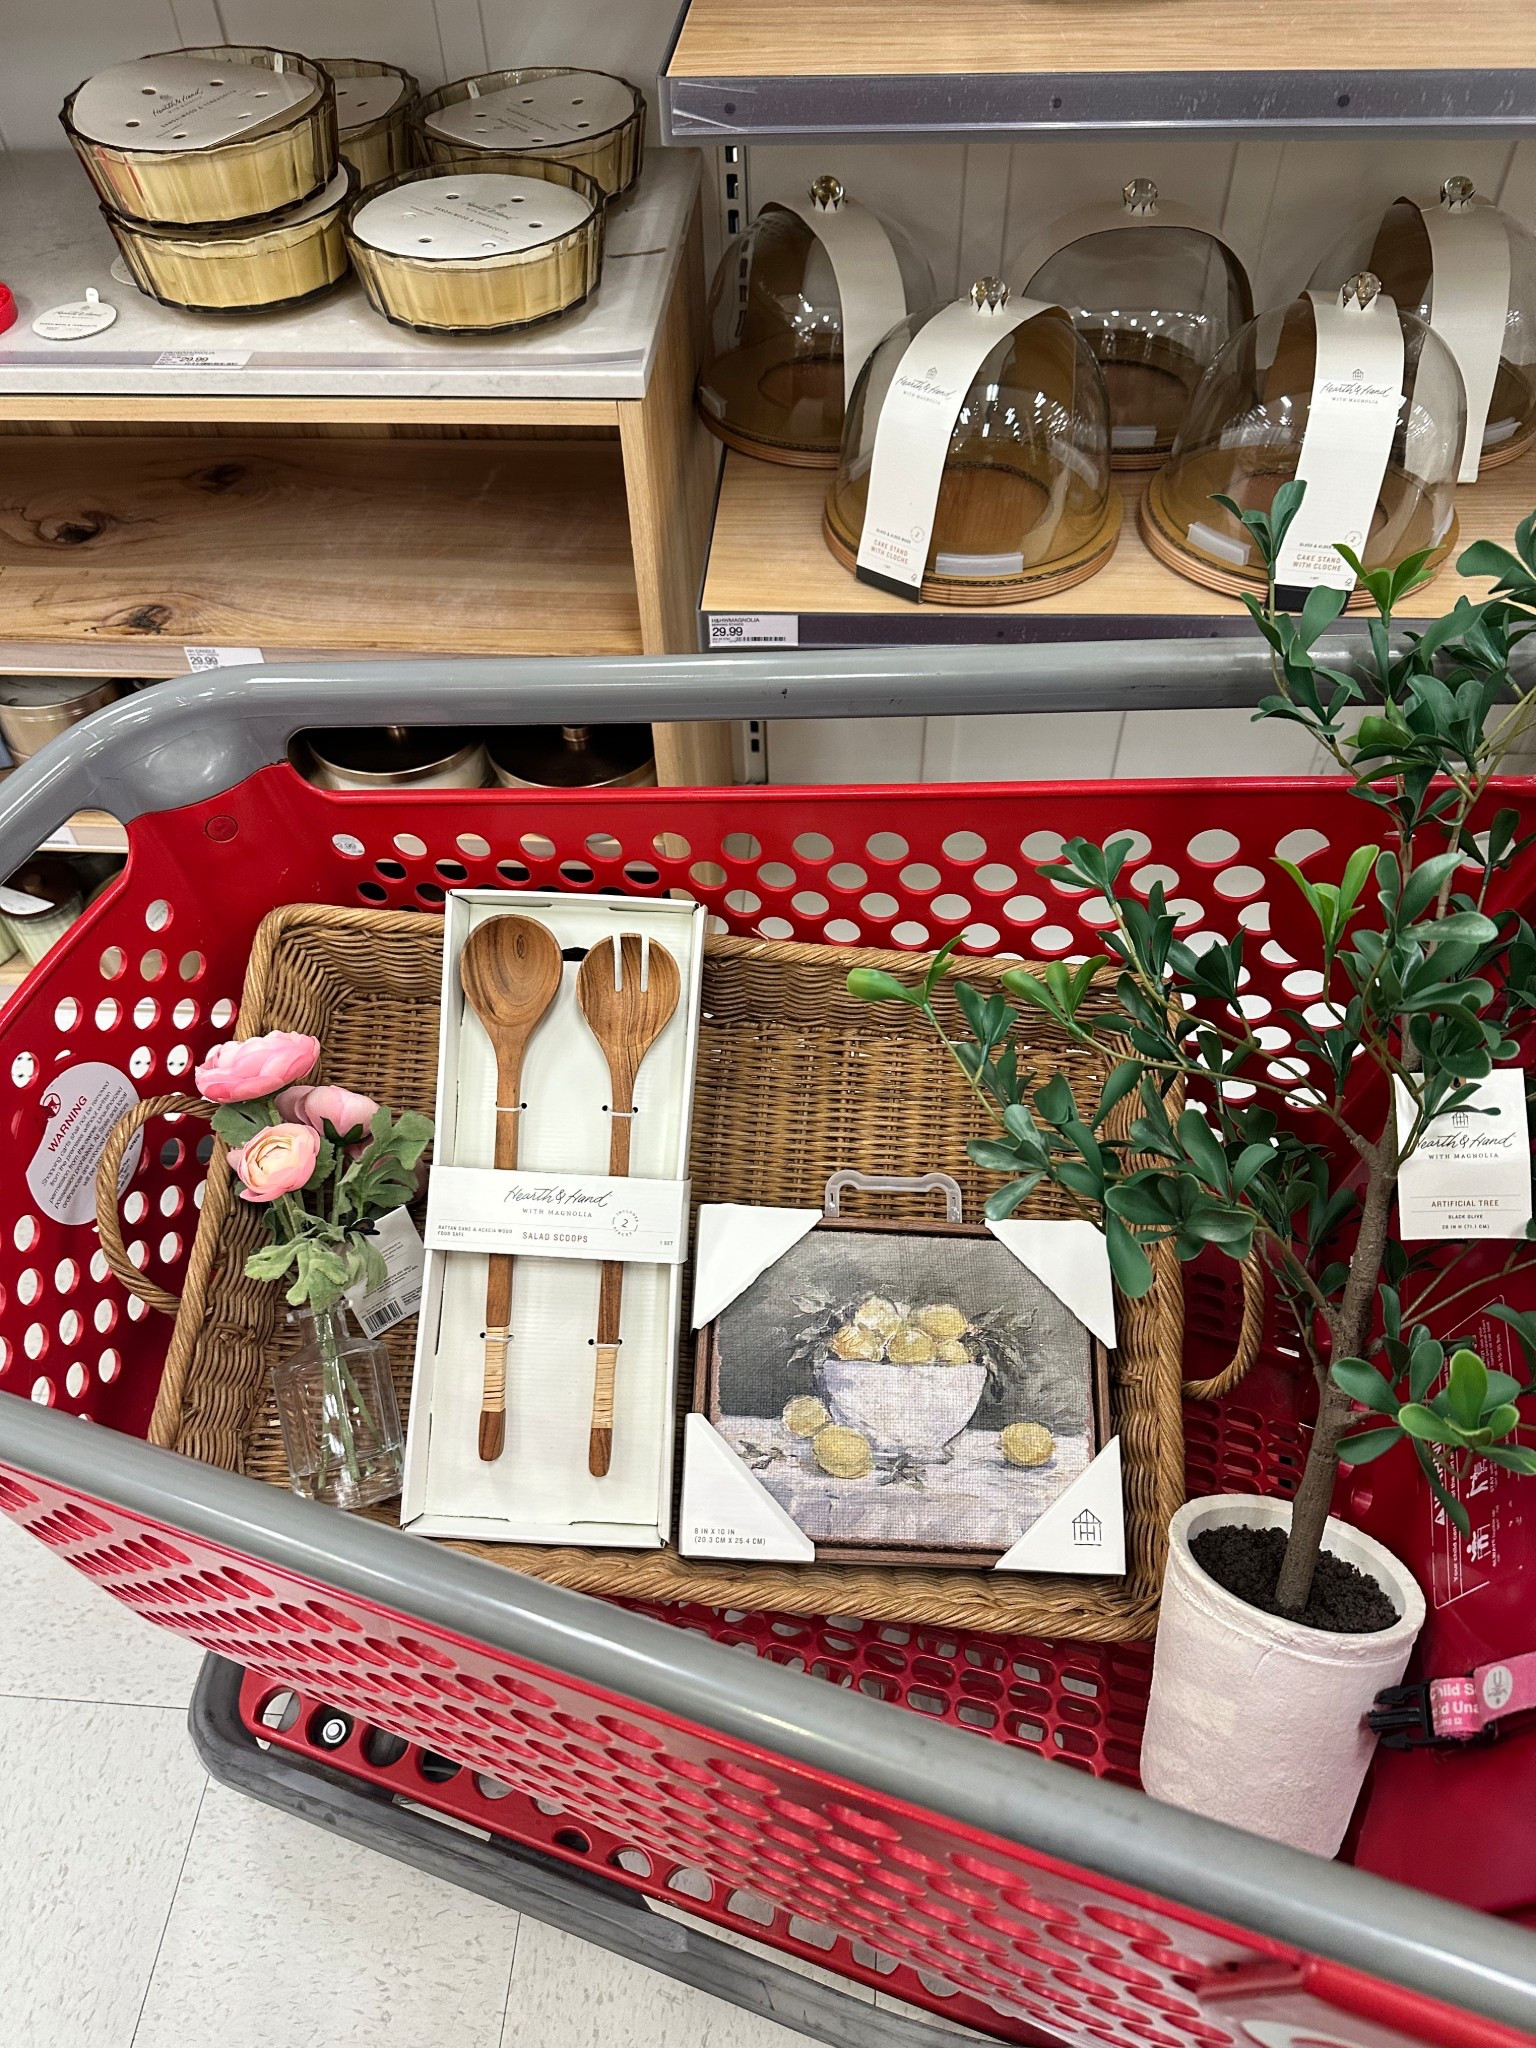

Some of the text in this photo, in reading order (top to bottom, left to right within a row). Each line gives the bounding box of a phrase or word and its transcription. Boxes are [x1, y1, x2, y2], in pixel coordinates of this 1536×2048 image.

[1319, 382, 1357, 395] Hearth
[871, 546, 908, 564] WITH CLOCHE
[874, 539, 909, 557] CAKE STAND
[1296, 554, 1341, 564] CAKE STAND
[1313, 563, 1342, 571] CLOCHE
[712, 627, 743, 636] 29.99
[190, 657, 218, 665] 29.99
[47, 1095, 88, 1153] WARNING
[41, 1156, 63, 1186] Shopping
[59, 1140, 72, 1156] carts
[78, 1115, 87, 1126] not
[85, 1105, 93, 1115] be
[91, 1080, 110, 1106] removed
[59, 1160, 68, 1171] the
[65, 1133, 85, 1161] premises
[82, 1111, 99, 1133] without
[1459, 1135, 1470, 1148] &
[1469, 1132, 1516, 1148] Hand
[47, 1169, 72, 1204] permission
[68, 1154, 80, 1169] from
[77, 1144, 86, 1155] the
[96, 1086, 123, 1124] Unauthorized
[52, 1174, 78, 1209] possession
[98, 1118, 111, 1134] State
[108, 1105, 118, 1118] and
[116, 1091, 128, 1106] local
[61, 1175, 85, 1209] ordinances
[504, 1185, 613, 1207] Hearth & Hand
[548, 1210, 592, 1218] MAGNOLIA
[621, 1219, 629, 1228] 2
[522, 1232, 588, 1243] SALAD SCOOPS
